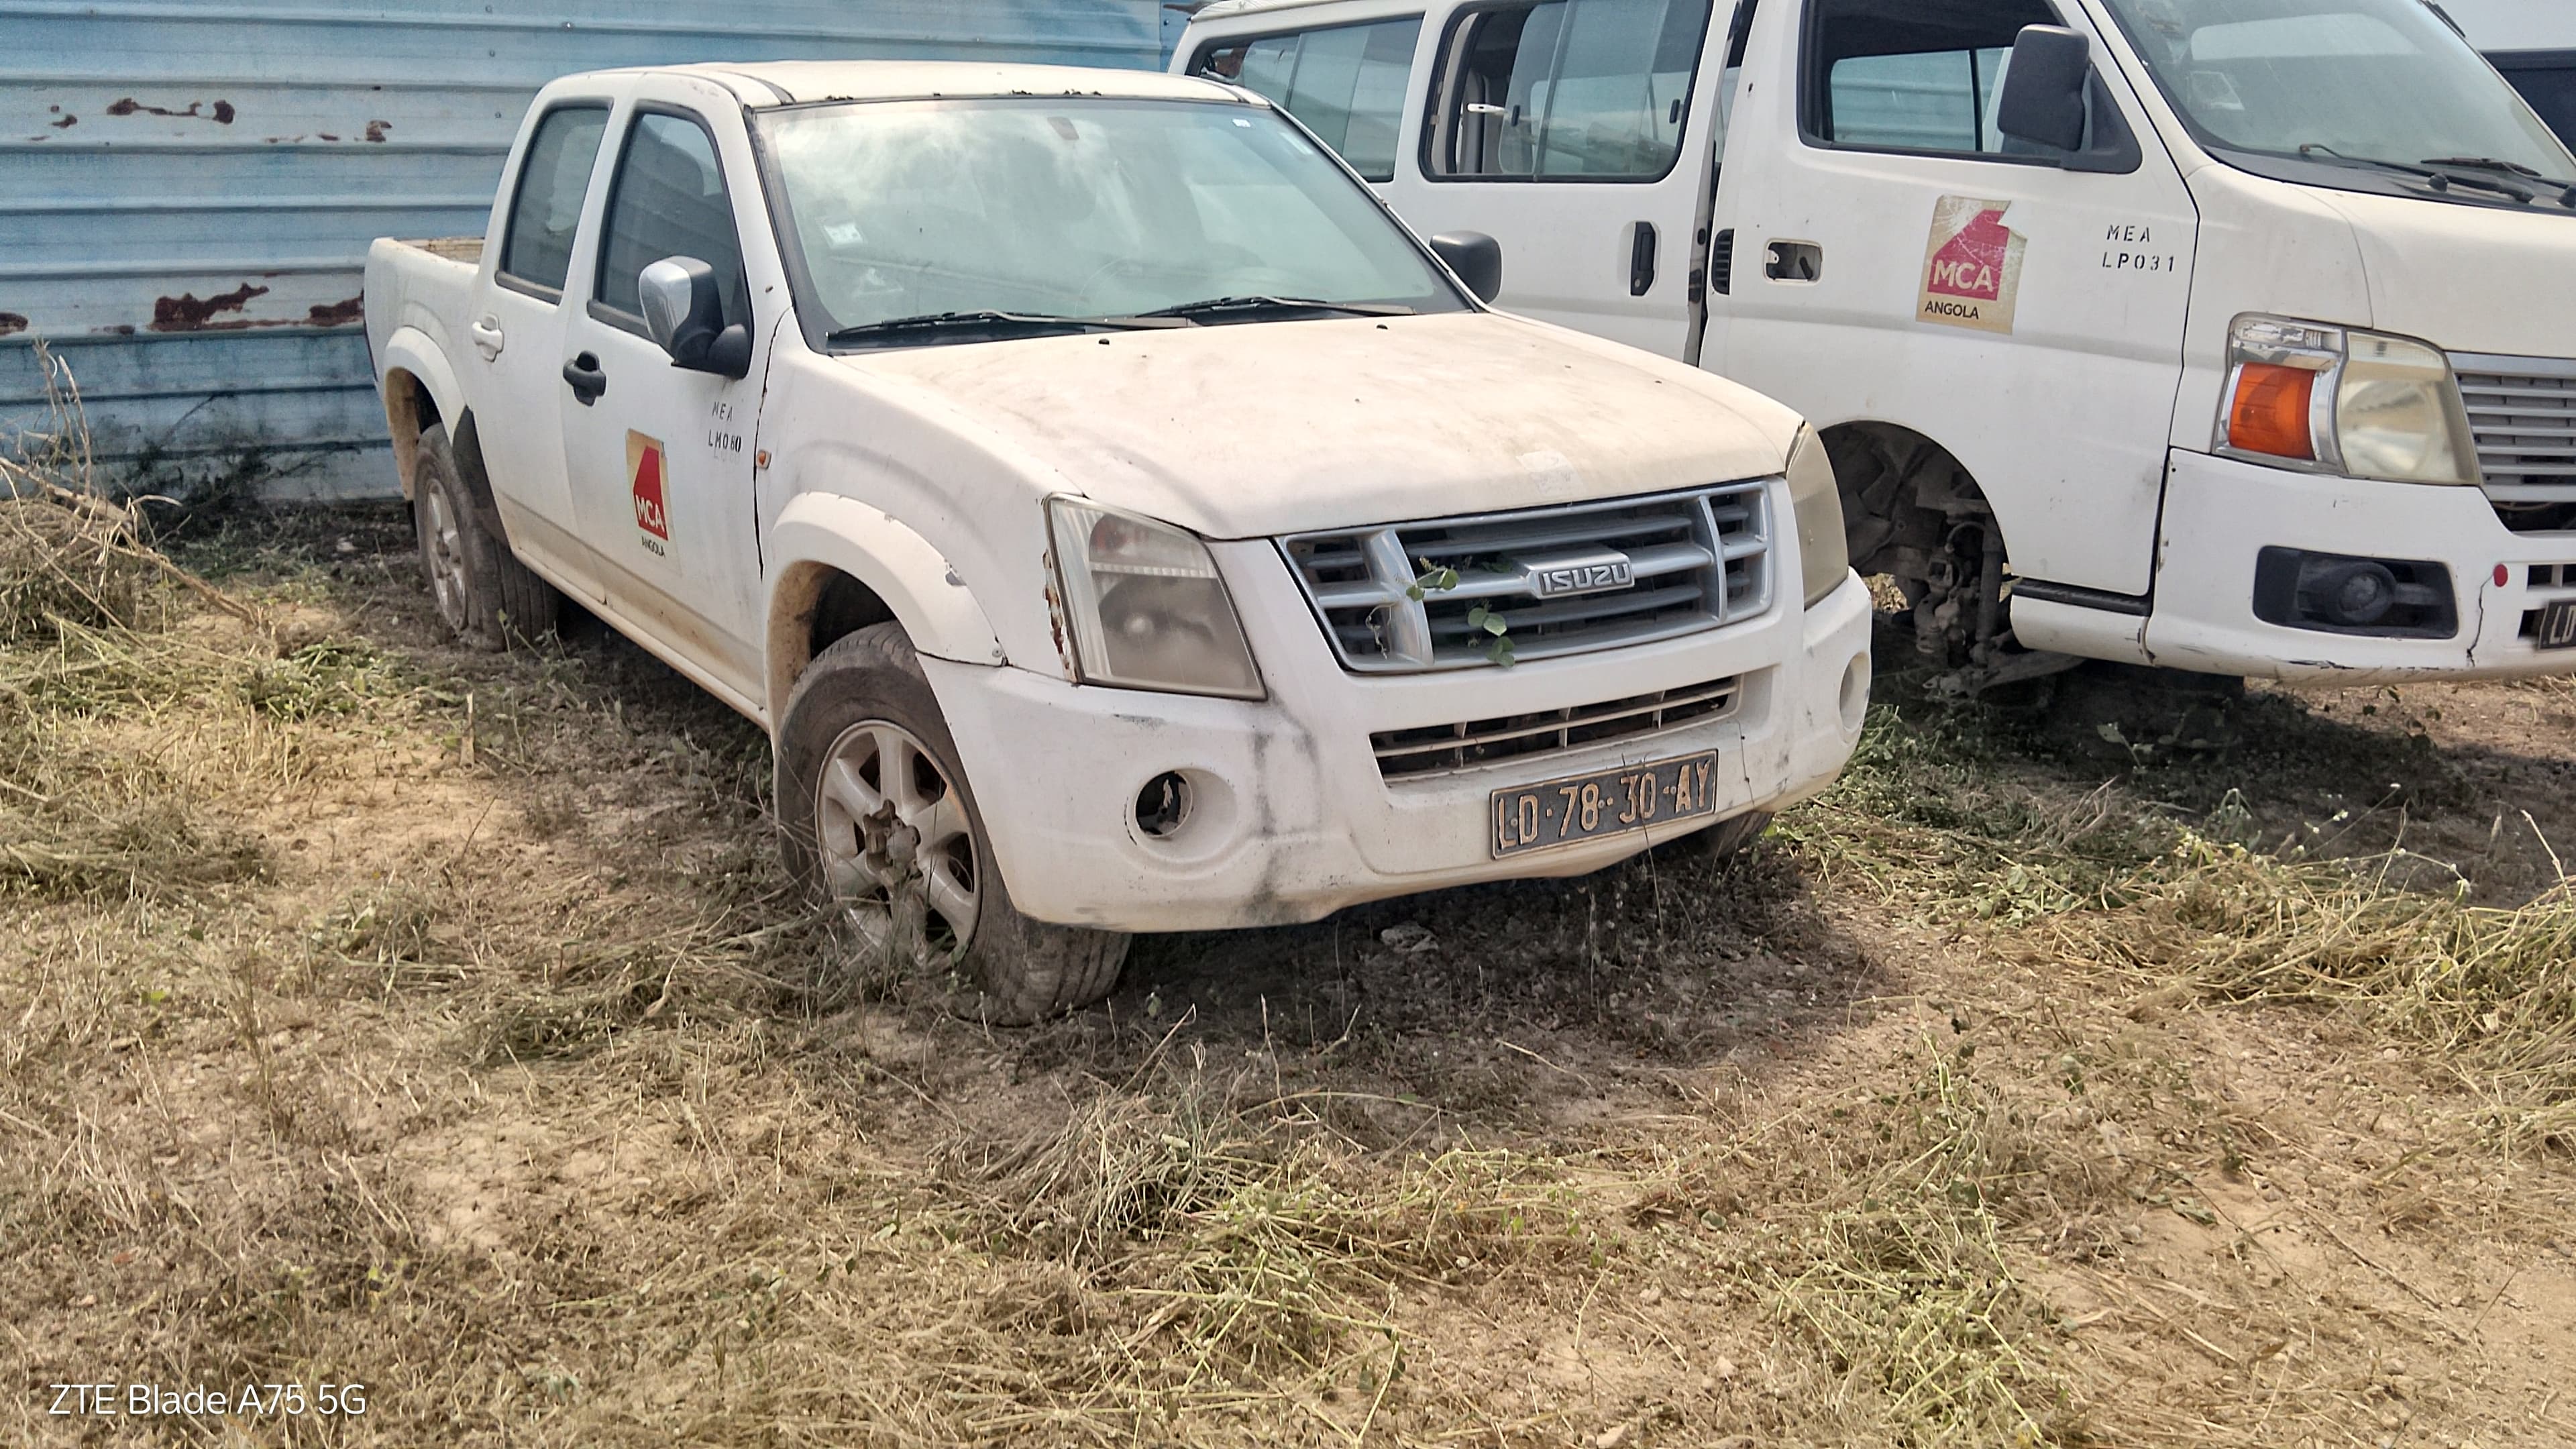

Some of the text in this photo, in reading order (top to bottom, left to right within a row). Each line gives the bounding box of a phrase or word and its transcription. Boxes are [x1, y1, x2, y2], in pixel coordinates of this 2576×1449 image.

[2106, 225, 2151, 244] MEA
[2102, 252, 2175, 273] LP031
[1932, 259, 1994, 293] MCA
[1924, 301, 1980, 320] ANGOLA
[712, 401, 733, 422] MEA
[635, 494, 665, 533] MCA
[641, 535, 666, 559] ANGOLA
[1543, 563, 1631, 592] ISUZU
